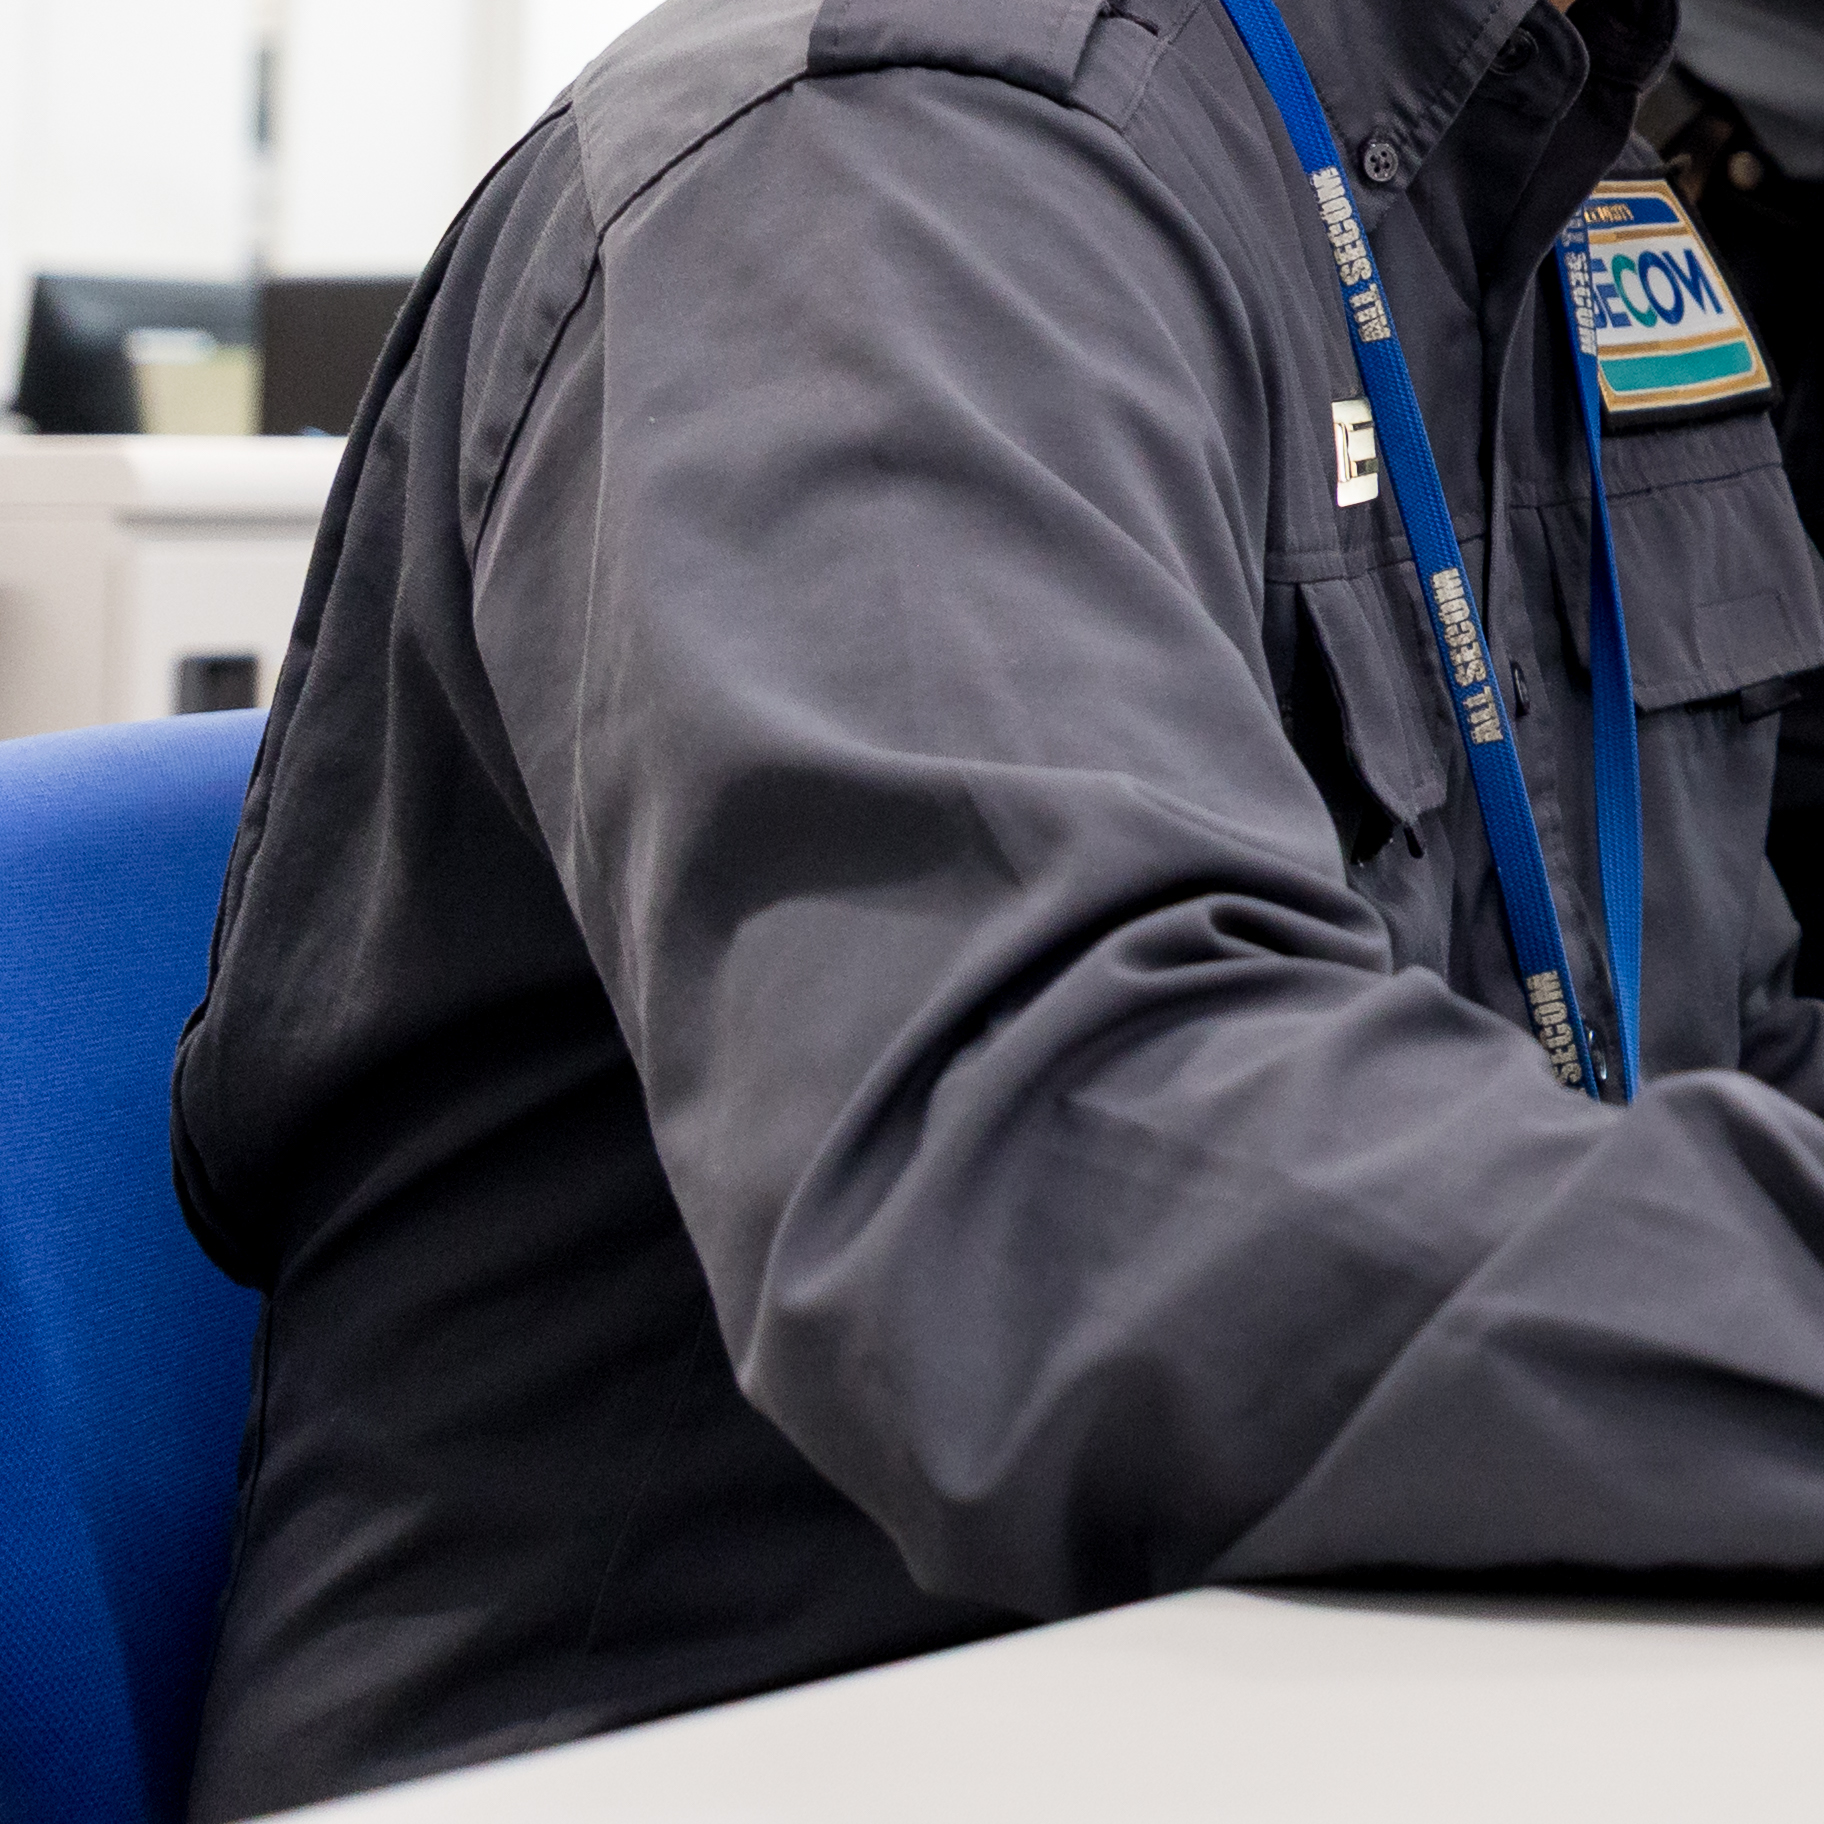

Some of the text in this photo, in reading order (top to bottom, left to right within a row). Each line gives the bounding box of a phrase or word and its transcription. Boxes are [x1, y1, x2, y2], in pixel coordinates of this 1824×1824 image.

[1310, 165, 1392, 343] ALL SECOM
[1563, 250, 1598, 357] SECOM
[1430, 566, 1505, 745] ALL SECOM
[1525, 968, 1583, 1086] SECOM
